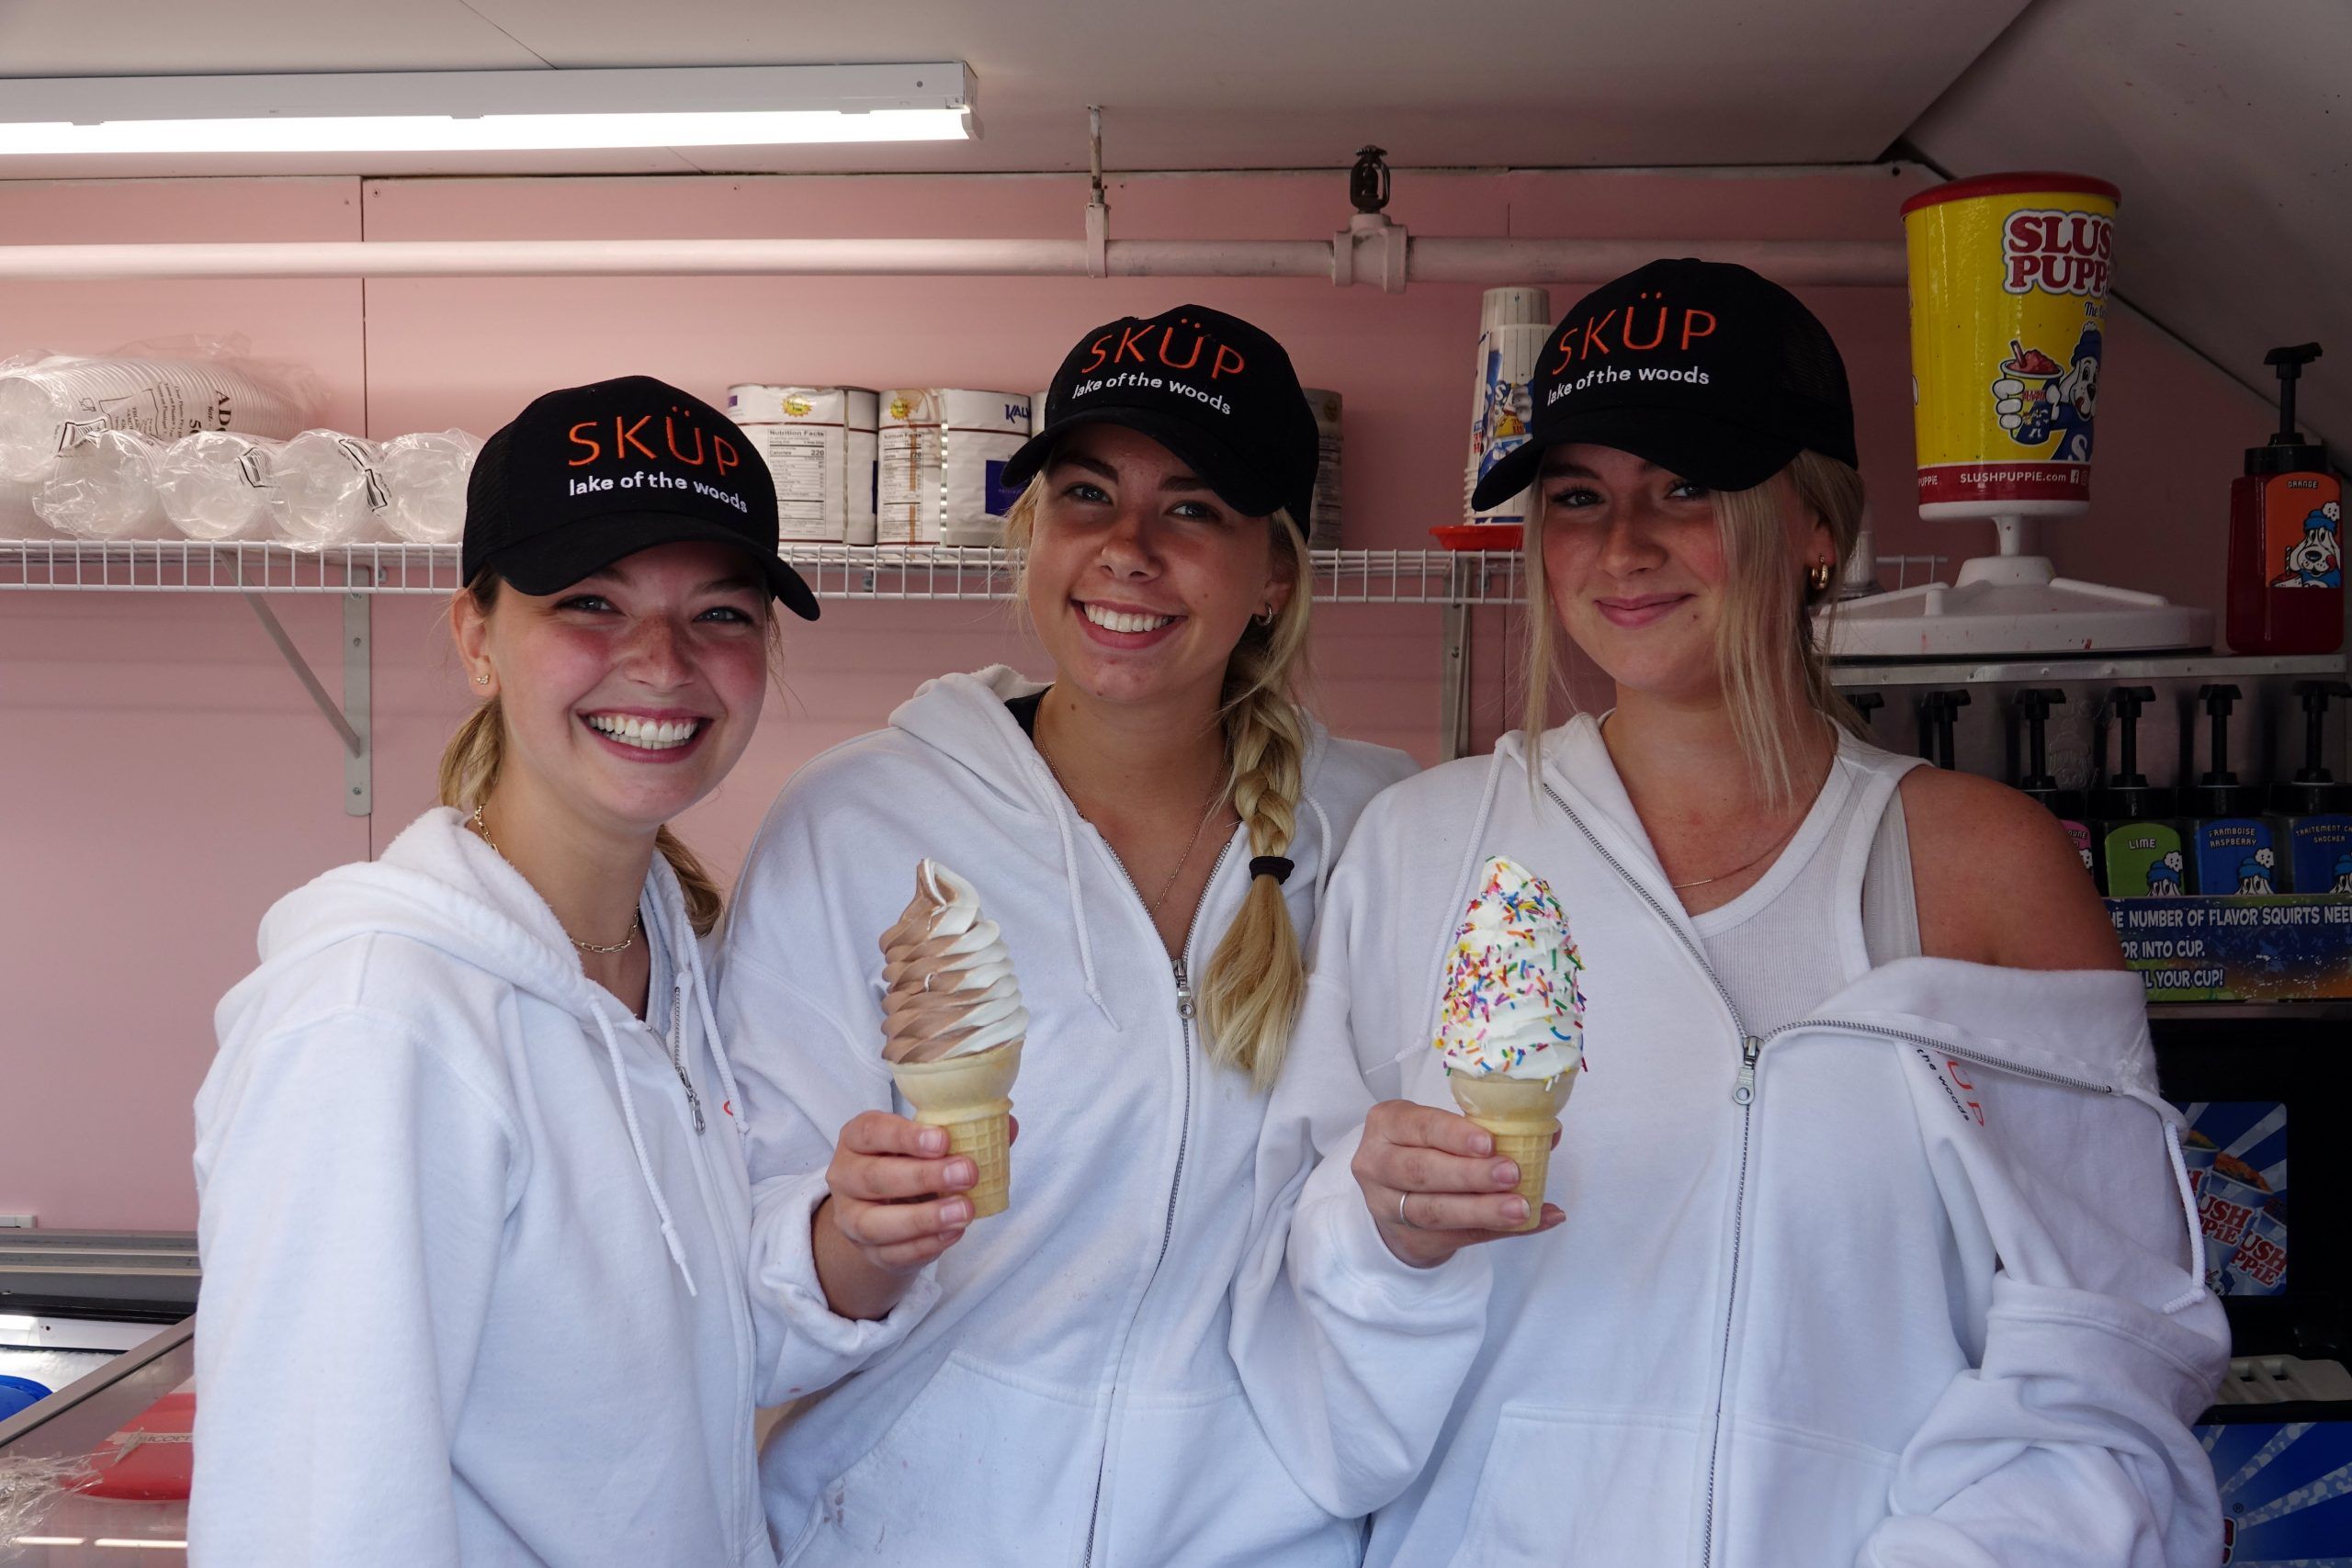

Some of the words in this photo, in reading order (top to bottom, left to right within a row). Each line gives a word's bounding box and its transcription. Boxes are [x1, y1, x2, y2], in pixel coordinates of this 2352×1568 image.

[2009, 255, 2109, 293] PUPP
[1081, 318, 1246, 379] SKÜP
[1552, 291, 1718, 376] SKÜP
[1072, 378, 1102, 400] lake
[1105, 372, 1128, 389] of
[1128, 372, 1163, 388] the
[1169, 379, 1231, 415] woods
[1547, 381, 1573, 407] lake
[1577, 369, 1597, 390] of
[1597, 366, 1632, 385] the
[1638, 366, 1710, 386] woods
[568, 406, 741, 476] SKÜP
[569, 475, 614, 496] lake
[620, 471, 644, 489] of
[648, 472, 688, 491] the
[693, 479, 749, 514] woods
[2288, 480, 2319, 490] ORANGE
[2128, 838, 2157, 850] LIME
[2209, 828, 2256, 838] FRAMBOISE
[2210, 837, 2257, 849] RASPBERRY
[2129, 909, 2184, 928] NUMBER
[2187, 908, 2205, 927] OF
[2209, 908, 2259, 927] FLAVOR
[2262, 906, 2321, 926] SQUIRTS
[2142, 941, 2174, 959] INTO
[2177, 940, 2206, 958] CUP.
[2154, 969, 2191, 988] YOUR
[2193, 969, 2224, 987] CUP!
[1939, 1076, 1970, 1121] woods
